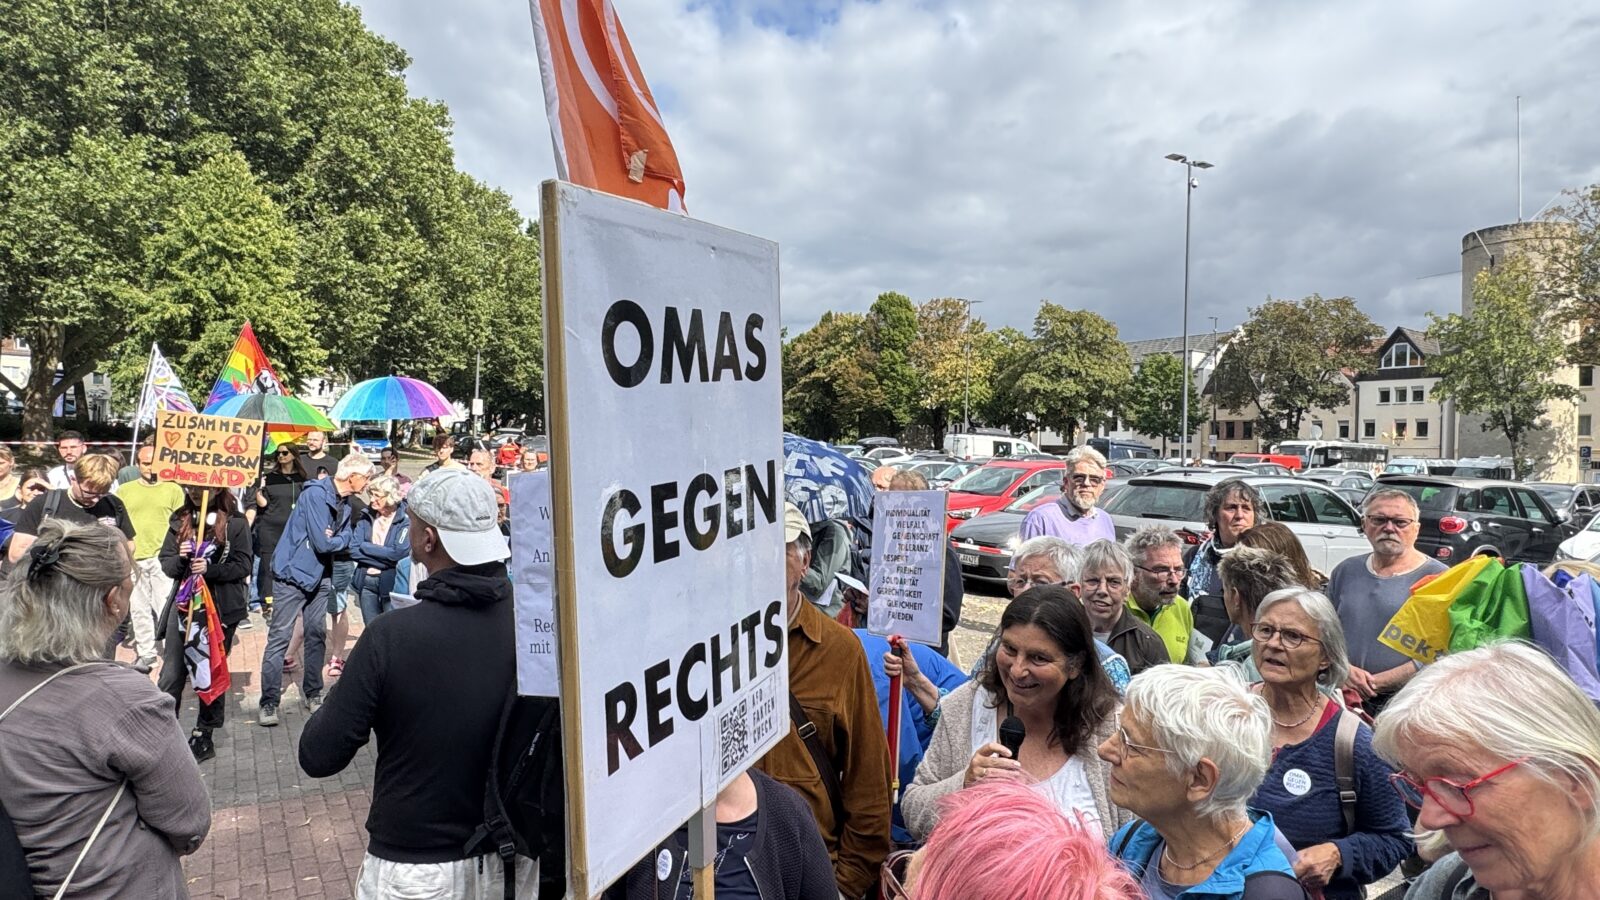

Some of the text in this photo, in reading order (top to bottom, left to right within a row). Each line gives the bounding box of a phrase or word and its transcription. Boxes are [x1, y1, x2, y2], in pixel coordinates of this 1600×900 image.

[601, 299, 767, 388] OMAS
[162, 413, 261, 436] ZUSAMMEN
[186, 432, 217, 450] für
[159, 447, 260, 470] PADERBORN
[159, 464, 207, 484] ohne
[601, 460, 778, 578] GEGEN
[896, 521, 925, 529] VIELFALT
[892, 532, 939, 541] GEMEINSCHAFT
[898, 543, 929, 552] TOLERANZ
[884, 554, 908, 562] RESPEKT
[897, 566, 923, 575] FREIHEIT
[882, 576, 919, 587] SOLIDARITÄT
[877, 587, 922, 599] GERECHTIGKEIT
[887, 600, 923, 611] GLEICHHEIT
[888, 611, 914, 622] FRIEDEN
[530, 640, 551, 654] mit
[605, 600, 784, 777] RECHTS
[753, 696, 775, 727] FAKTEN
[752, 717, 772, 743] CHECK
